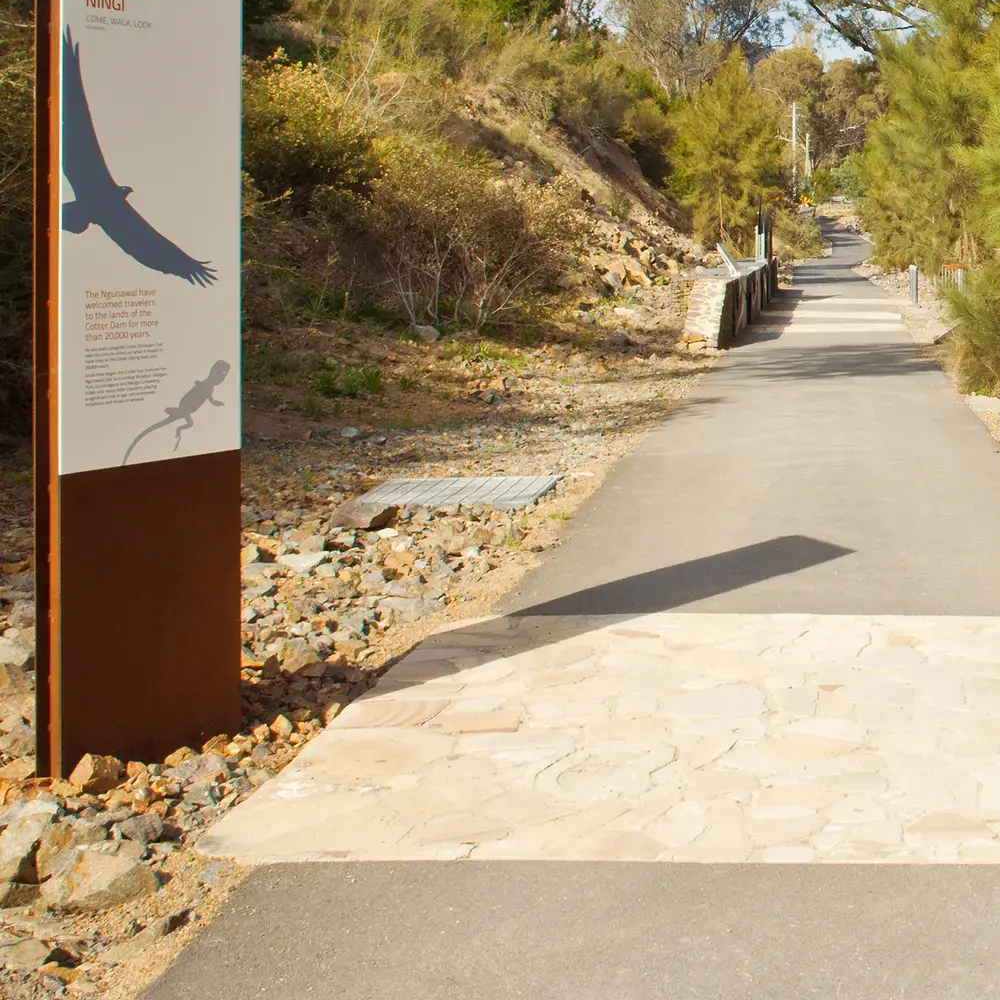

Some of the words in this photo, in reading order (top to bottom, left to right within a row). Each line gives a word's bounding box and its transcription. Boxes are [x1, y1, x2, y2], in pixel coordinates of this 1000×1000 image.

[133, 20, 153, 29] LOOK
[85, 290, 99, 298] The
[101, 289, 137, 299] Ngunawal
[139, 288, 156, 297] have
[85, 300, 122, 309] welcomed
[124, 299, 156, 307] travelers
[85, 312, 93, 320] to
[95, 311, 107, 319] the
[109, 310, 129, 319] lands
[130, 309, 138, 317] of
[139, 309, 152, 317] the
[85, 322, 108, 331] Cotter
[110, 321, 127, 329] Dam
[128, 320, 139, 328] for
[140, 319, 159, 327] more
[85, 333, 102, 341] than
[104, 331, 128, 340] 20,000
[130, 330, 151, 339] years.
